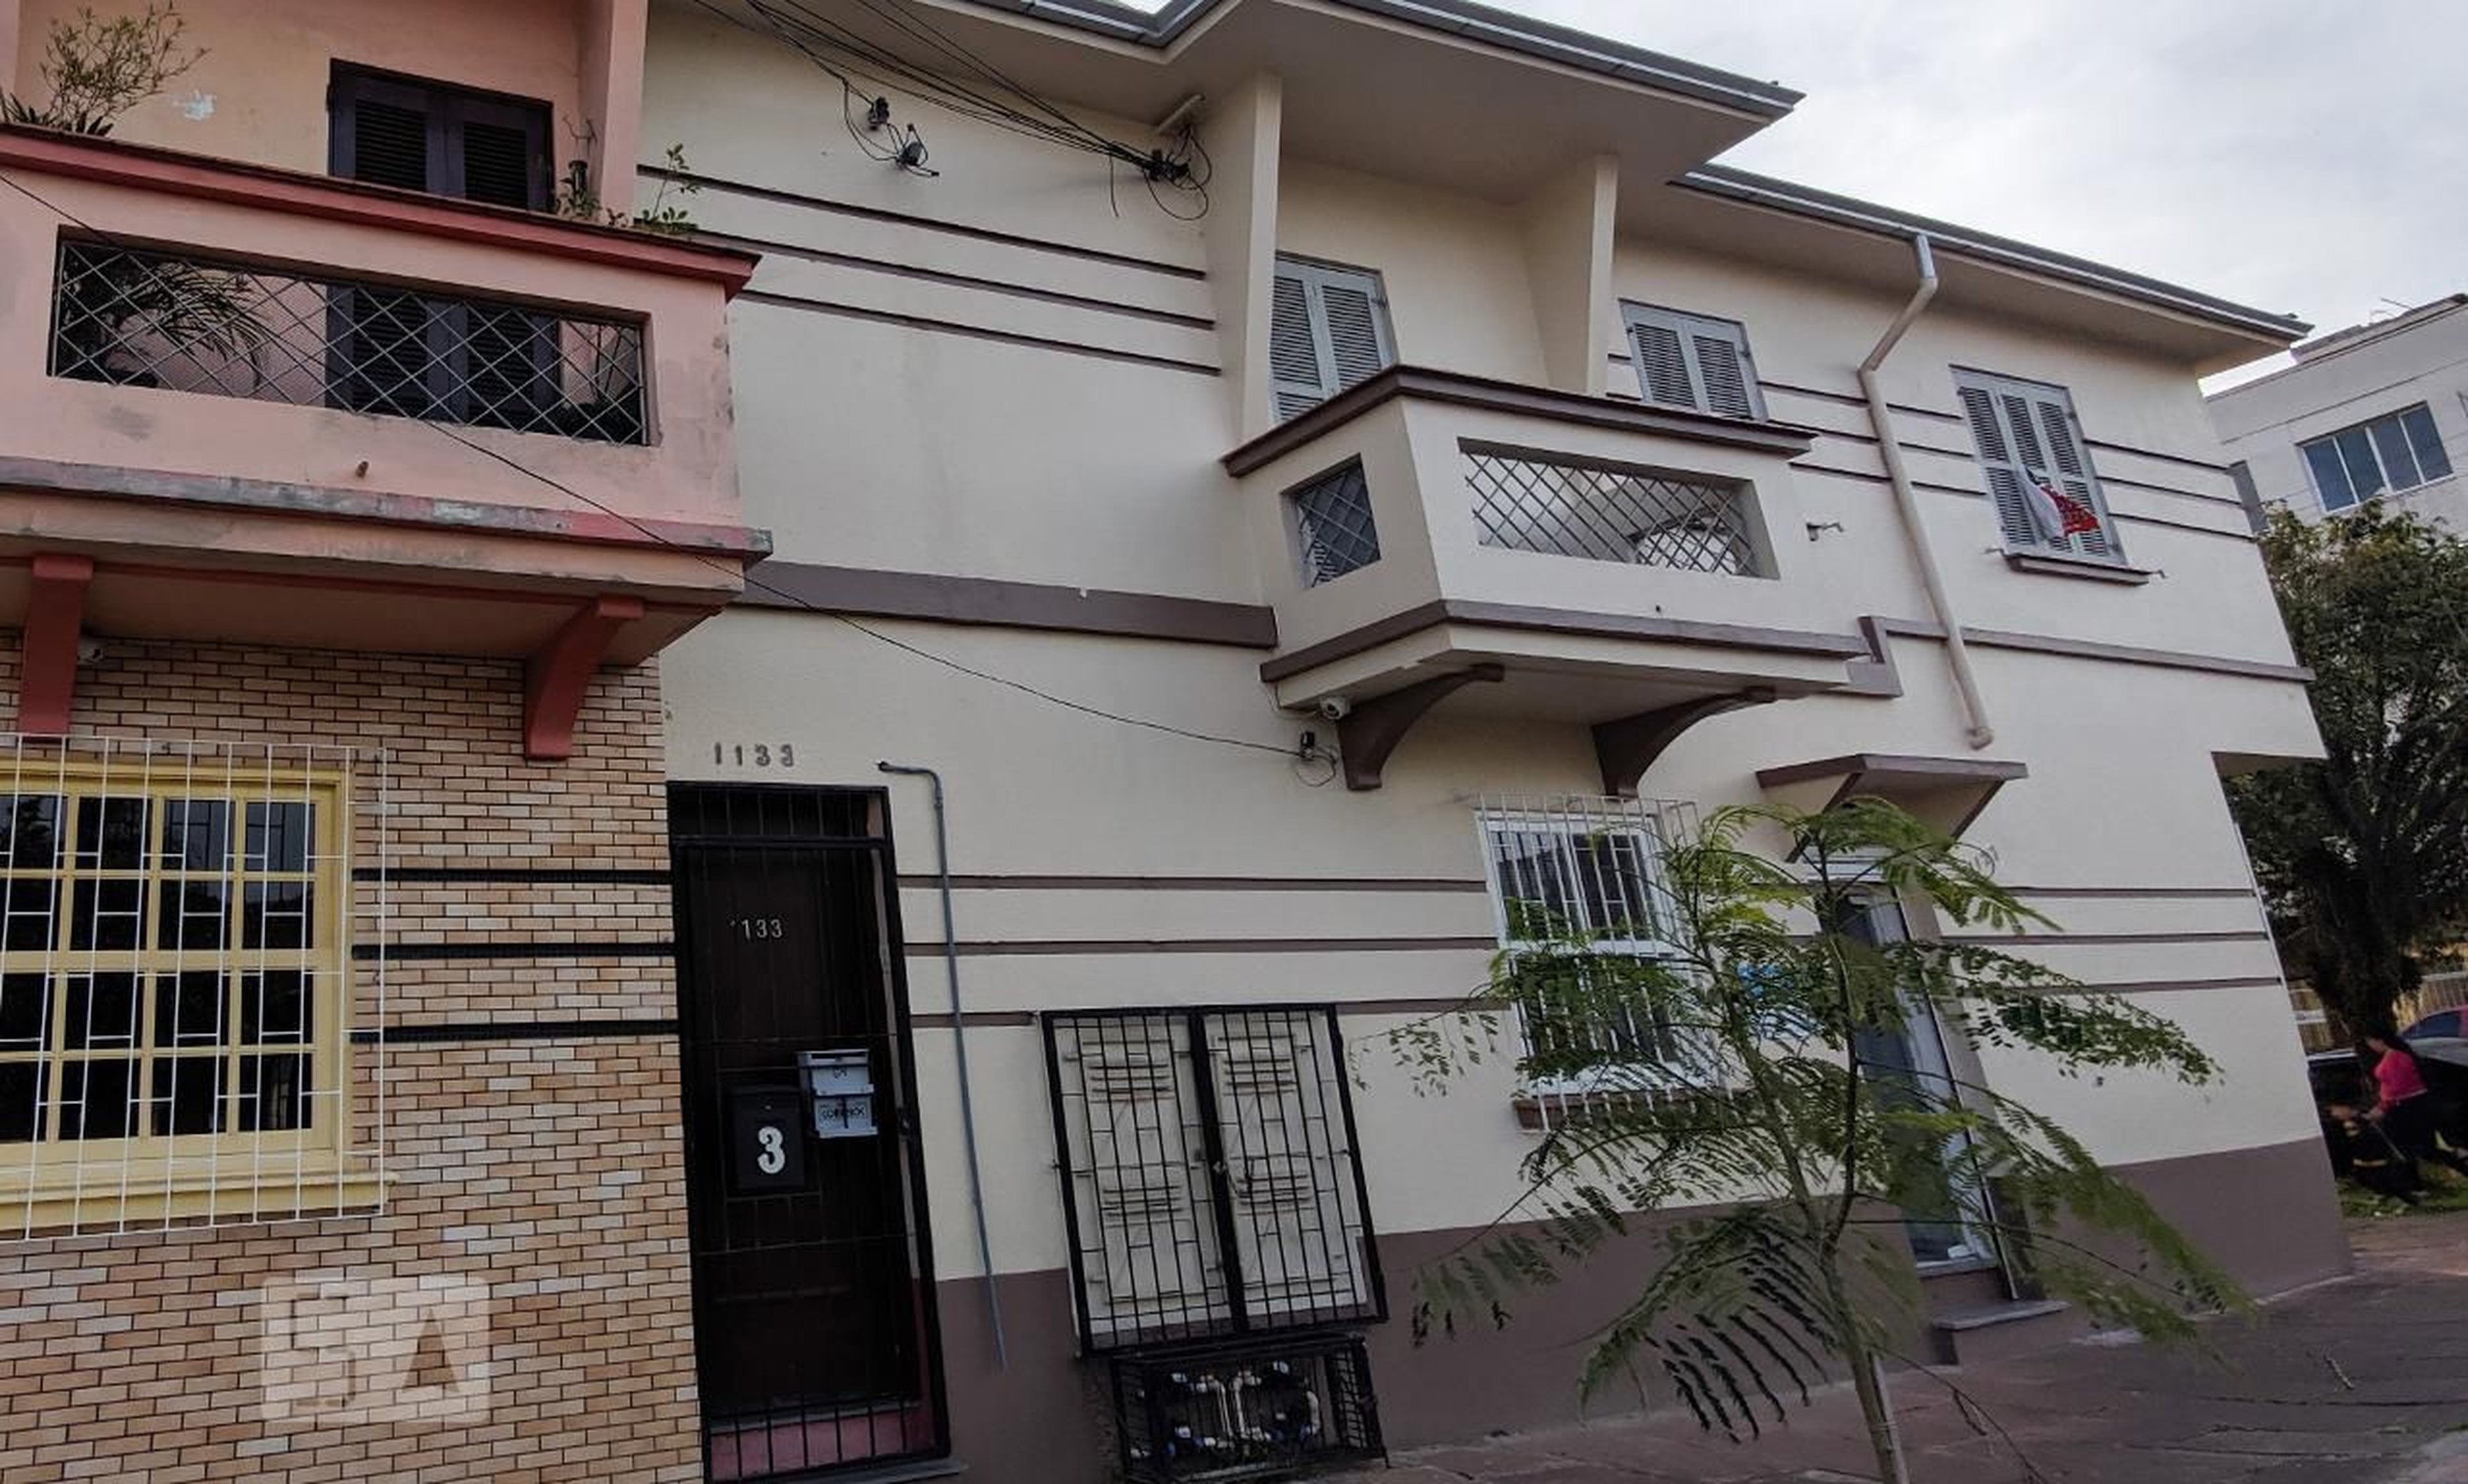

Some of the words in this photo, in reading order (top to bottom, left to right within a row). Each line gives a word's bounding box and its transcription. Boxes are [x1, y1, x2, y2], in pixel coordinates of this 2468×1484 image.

[713, 741, 796, 767] 1133
[729, 918, 783, 940] 133
[756, 1125, 786, 1174] 3
